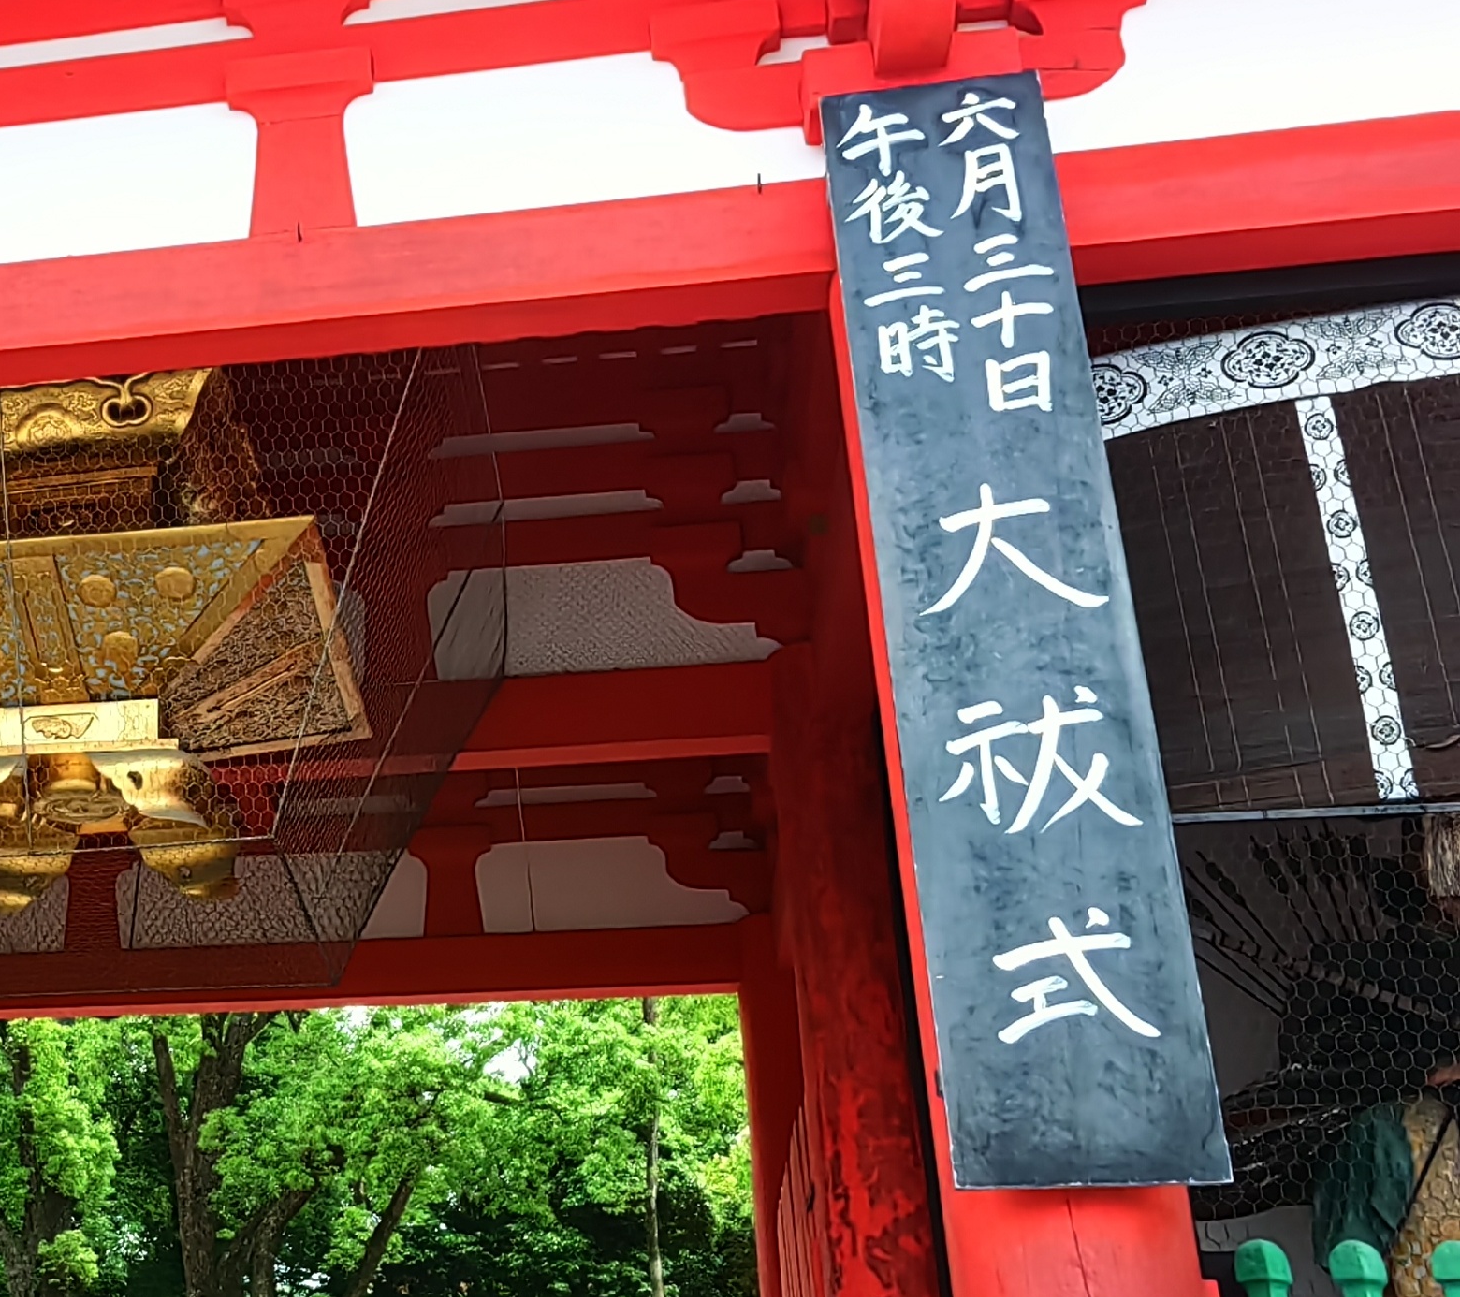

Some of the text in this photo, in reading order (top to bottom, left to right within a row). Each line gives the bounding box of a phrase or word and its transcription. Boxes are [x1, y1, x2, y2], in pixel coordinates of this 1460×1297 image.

[837, 104, 960, 383] 午後三時
[938, 92, 1054, 413] 六月三十日
[919, 483, 1161, 1044] 大祓式
